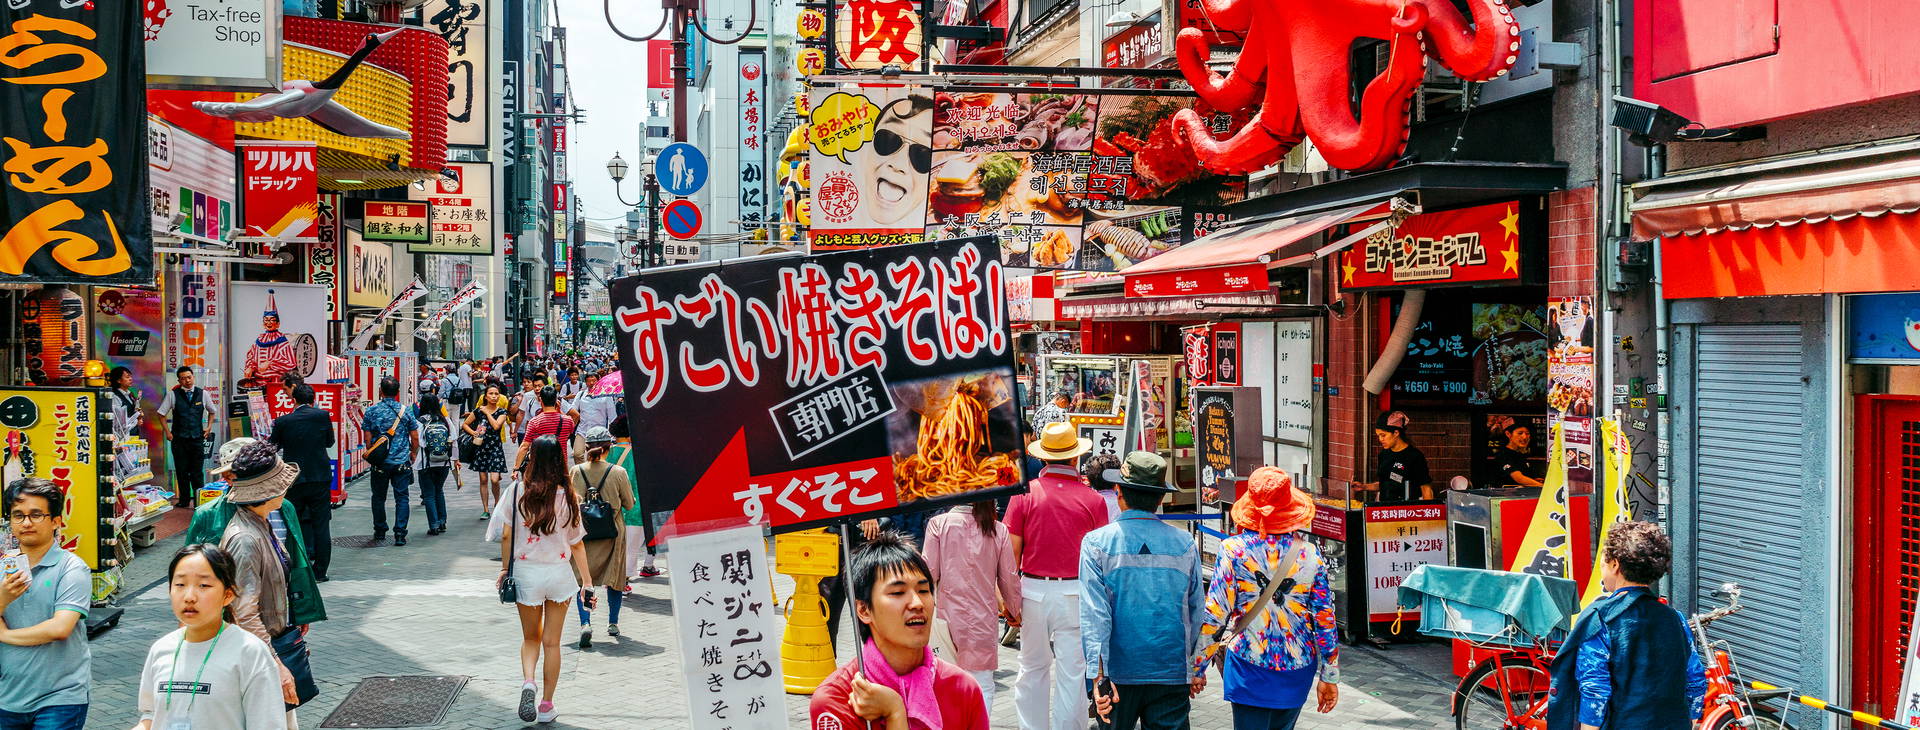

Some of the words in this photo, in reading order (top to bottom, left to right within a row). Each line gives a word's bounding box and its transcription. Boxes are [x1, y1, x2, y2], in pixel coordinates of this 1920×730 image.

[187, 5, 261, 23] Tax-free
[215, 26, 261, 46] Shop
[815, 103, 869, 138] おみやげ
[946, 104, 1020, 123] 欢迎光临
[949, 124, 1019, 142] 어서오세요
[0, 13, 132, 276] らーめん
[247, 150, 315, 172] ツルハ
[248, 176, 302, 191] ドラッグ
[1029, 175, 1128, 197] 해선호프집
[382, 205, 408, 216] 地階
[741, 162, 762, 242] かに道
[943, 211, 1046, 228] 大阪名产物
[665, 245, 699, 256] 自動車
[1365, 232, 1486, 273] コナモンミュージアム
[205, 274, 216, 316] 免税店
[168, 302, 177, 318] TAX
[168, 322, 177, 343] FREE
[616, 242, 1007, 409] すごい焼きそば!
[60, 298, 84, 382] ラーメン
[168, 345, 177, 368] SHOP
[1405, 381, 1429, 393] ¥650
[787, 376, 880, 443] 専門店
[733, 467, 884, 525] すぐそこ
[1371, 508, 1441, 520] 営業時間のご案内
[1396, 526, 1418, 537] 平日
[1372, 540, 1401, 554] 11時
[1414, 538, 1443, 552] 22時
[689, 562, 731, 730] 食べた焼きそ
